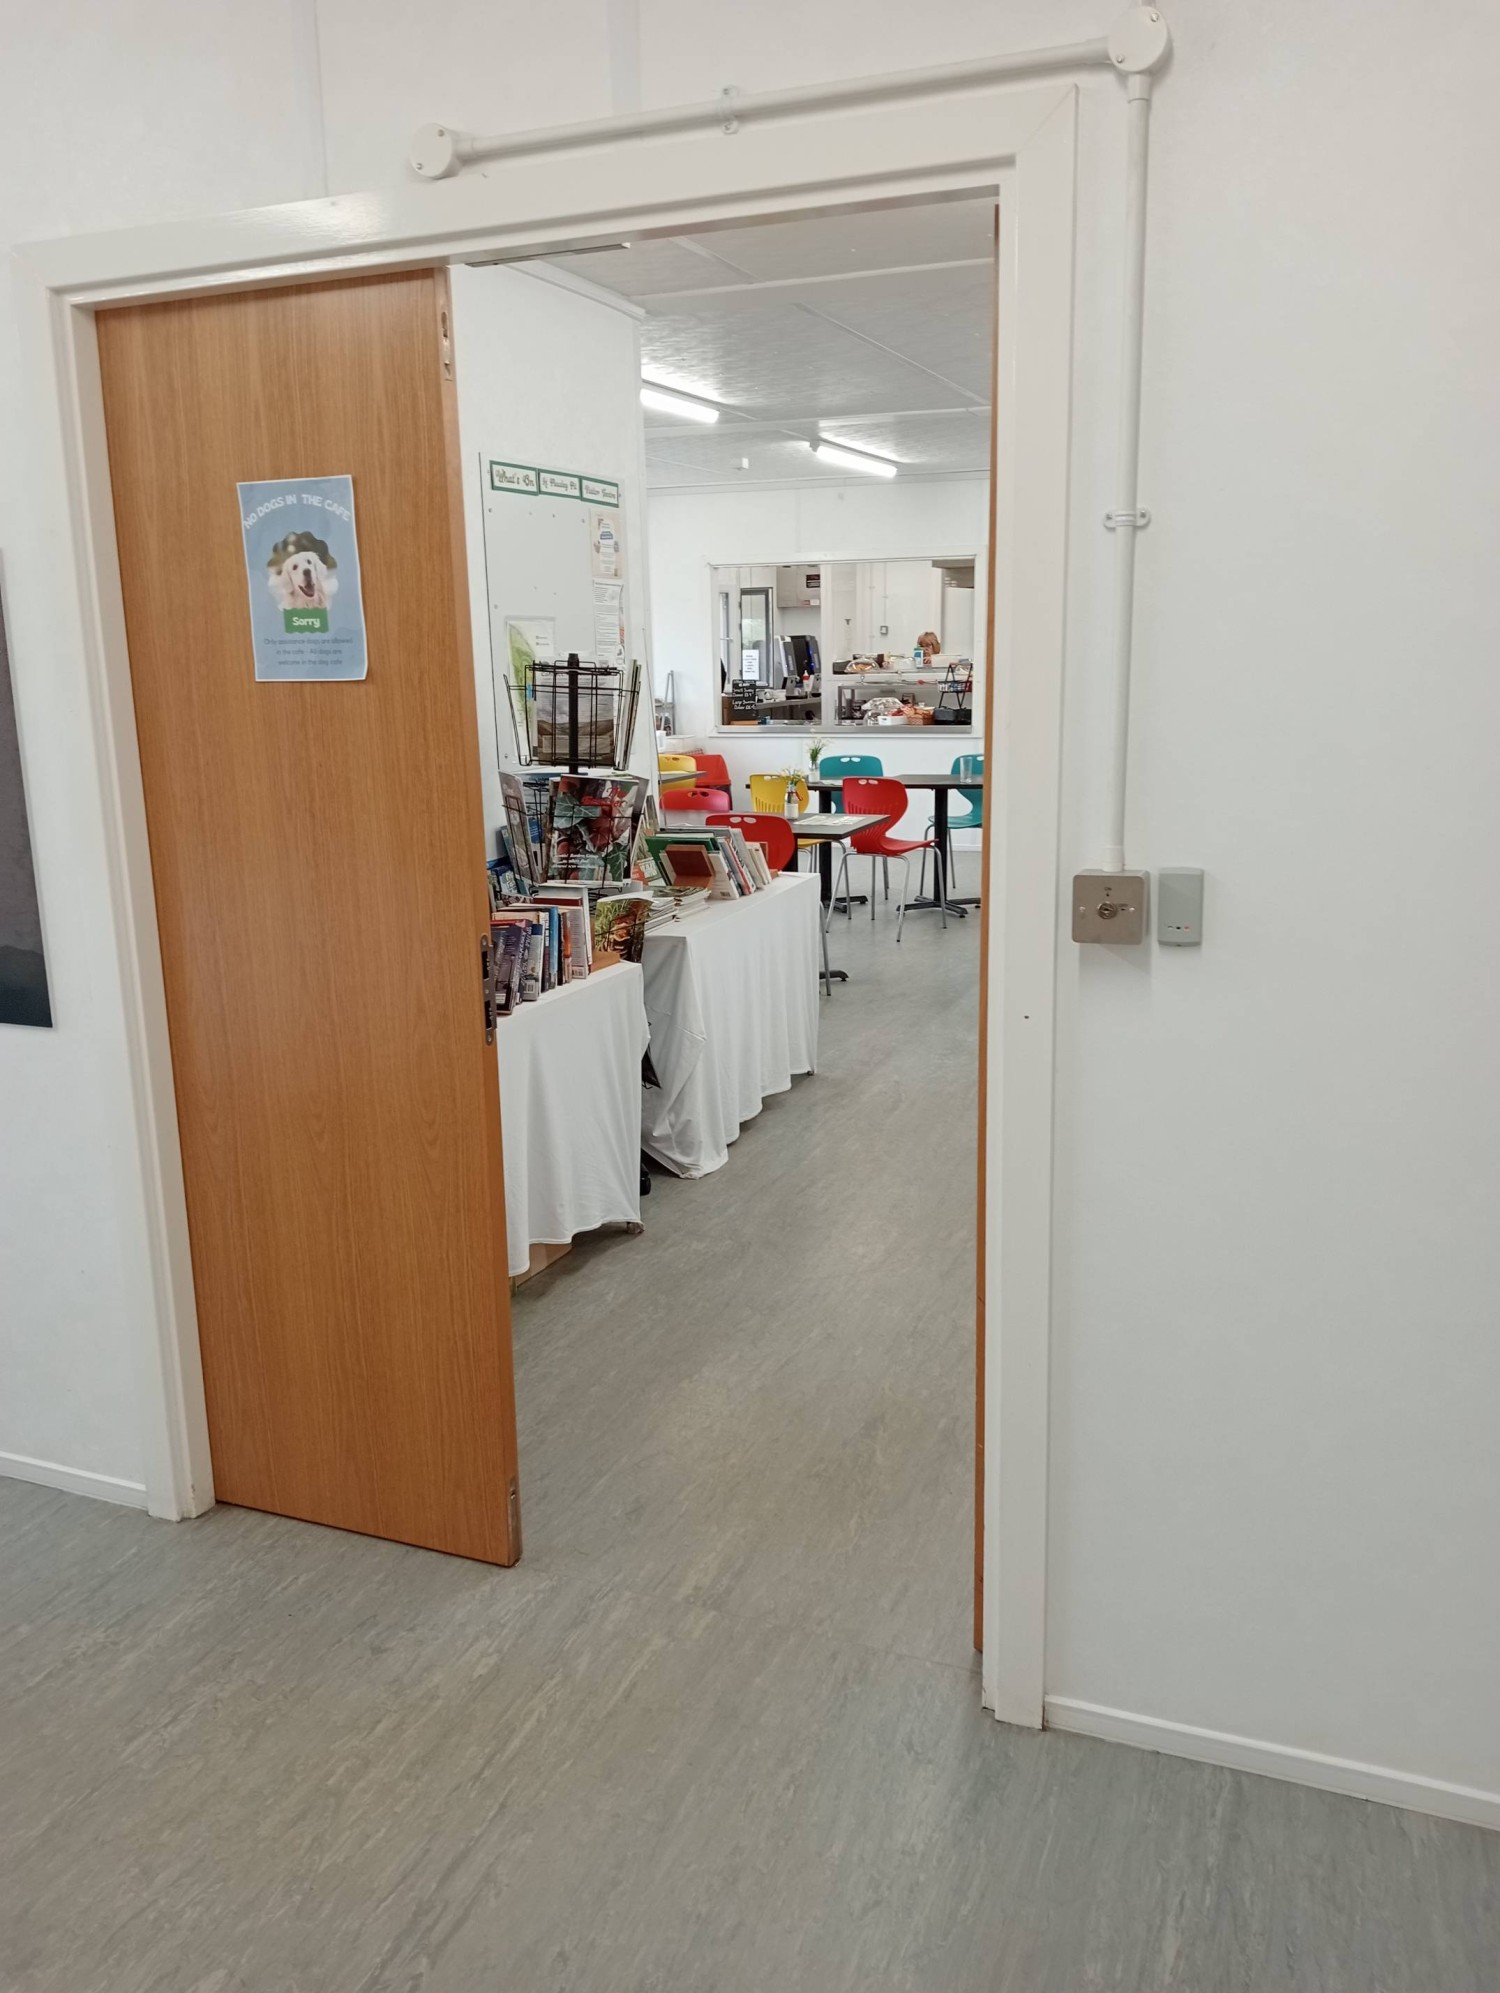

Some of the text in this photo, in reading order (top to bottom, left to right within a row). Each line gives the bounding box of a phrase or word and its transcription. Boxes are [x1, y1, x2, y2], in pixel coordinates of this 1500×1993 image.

[243, 494, 352, 529] NO DOGS IN THE CAFE
[292, 616, 321, 628] Sorry
